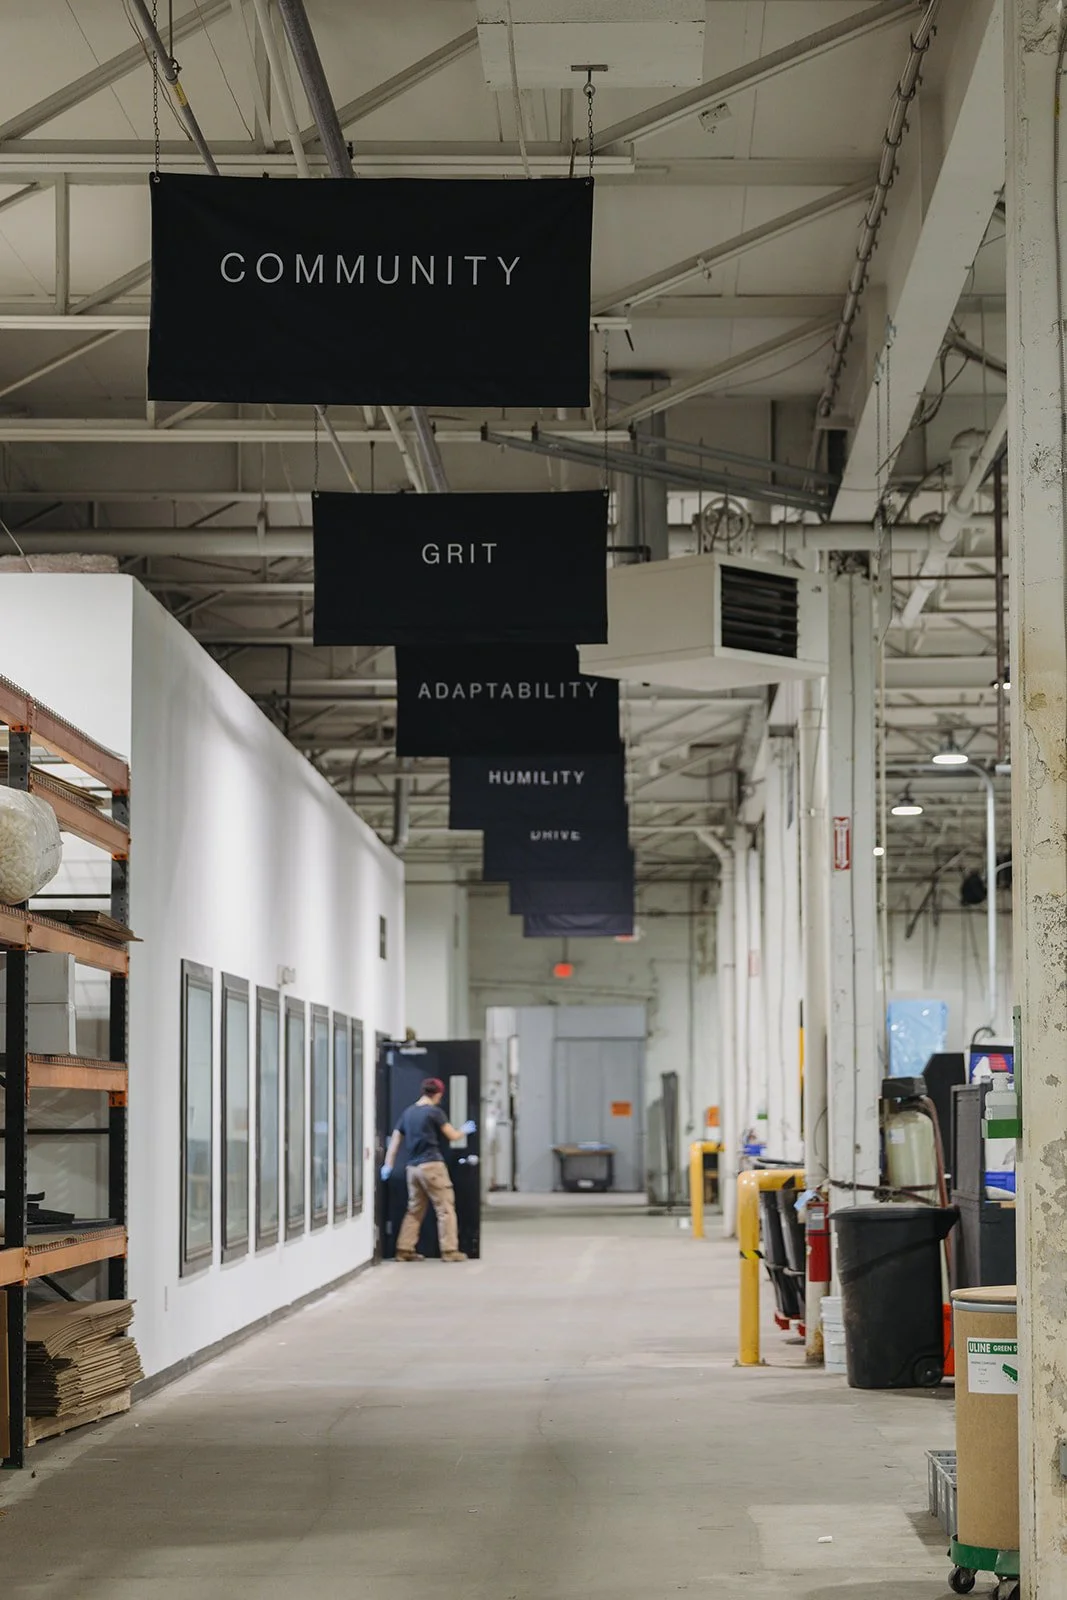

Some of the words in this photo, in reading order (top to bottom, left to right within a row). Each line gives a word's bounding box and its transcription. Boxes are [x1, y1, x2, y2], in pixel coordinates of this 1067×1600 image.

[220, 252, 521, 286] COMMUNITY
[421, 543, 498, 565] GRIT
[418, 681, 599, 700] ADAPTABILITY
[488, 770, 585, 786] HUMILITY
[969, 1342, 991, 1353] ULINE
